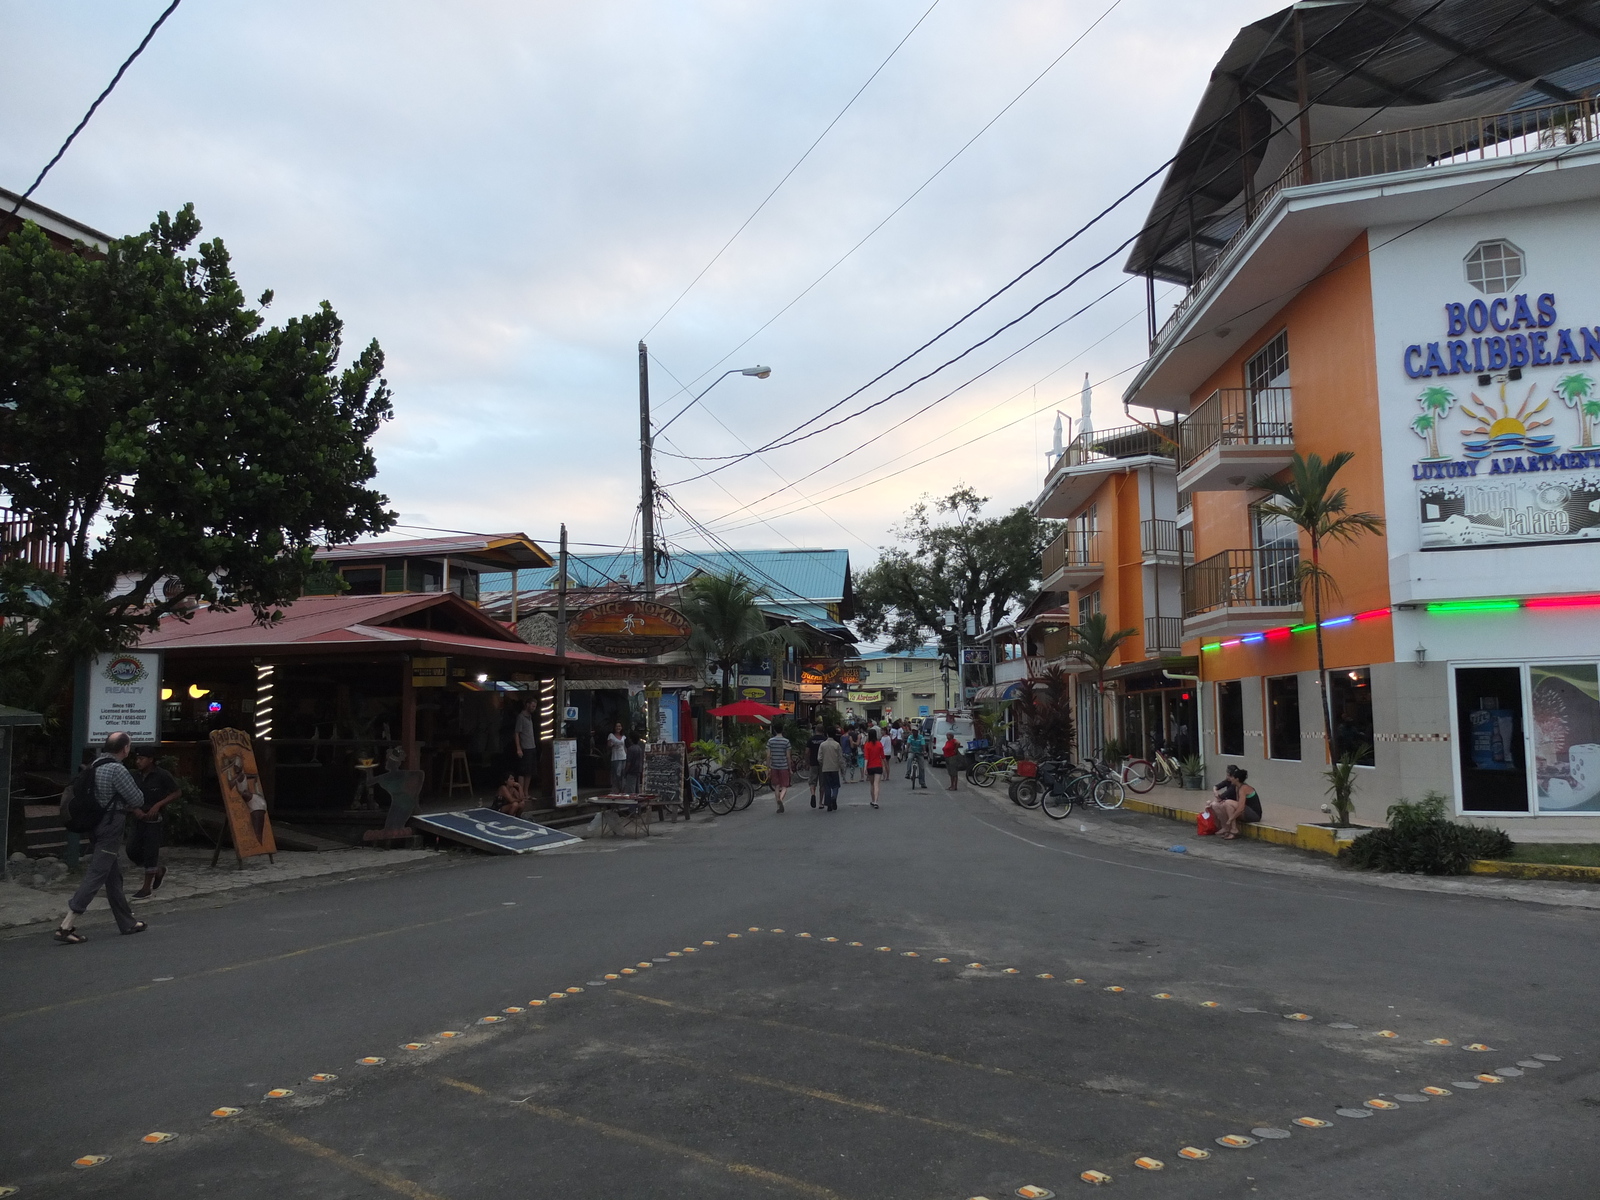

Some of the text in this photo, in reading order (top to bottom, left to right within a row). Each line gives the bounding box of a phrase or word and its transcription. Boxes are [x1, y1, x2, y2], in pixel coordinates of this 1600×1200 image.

[1445, 293, 1557, 337] BOCAS
[1404, 326, 1600, 378] CARIBBEAN
[1412, 460, 1480, 480] LUXURY
[1464, 483, 1517, 519] Royal
[1503, 507, 1570, 536] Palace
[590, 601, 624, 619] NICE
[634, 602, 690, 635] NOMADS
[605, 646, 649, 654] EXPEDITIONS
[105, 686, 144, 694] REALTY
